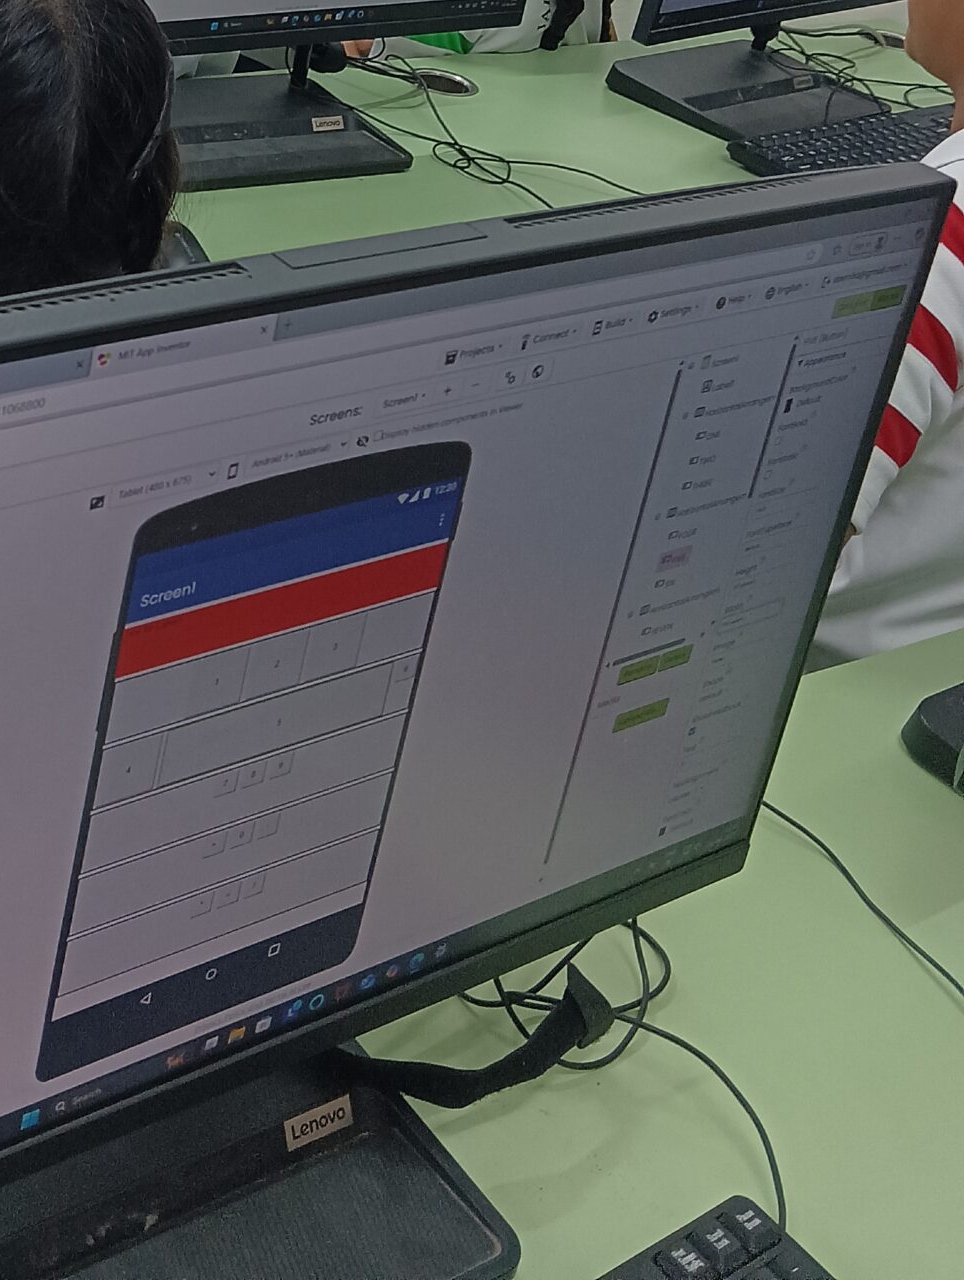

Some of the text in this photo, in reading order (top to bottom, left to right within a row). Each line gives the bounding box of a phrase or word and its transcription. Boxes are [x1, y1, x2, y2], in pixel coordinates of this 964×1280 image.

[314, 118, 342, 129] Lenovo
[532, 329, 570, 345] Connect
[459, 344, 495, 360] Projects
[309, 405, 364, 426] Screens:
[139, 581, 197, 608] Screen1
[290, 1104, 347, 1141] Lenovo
